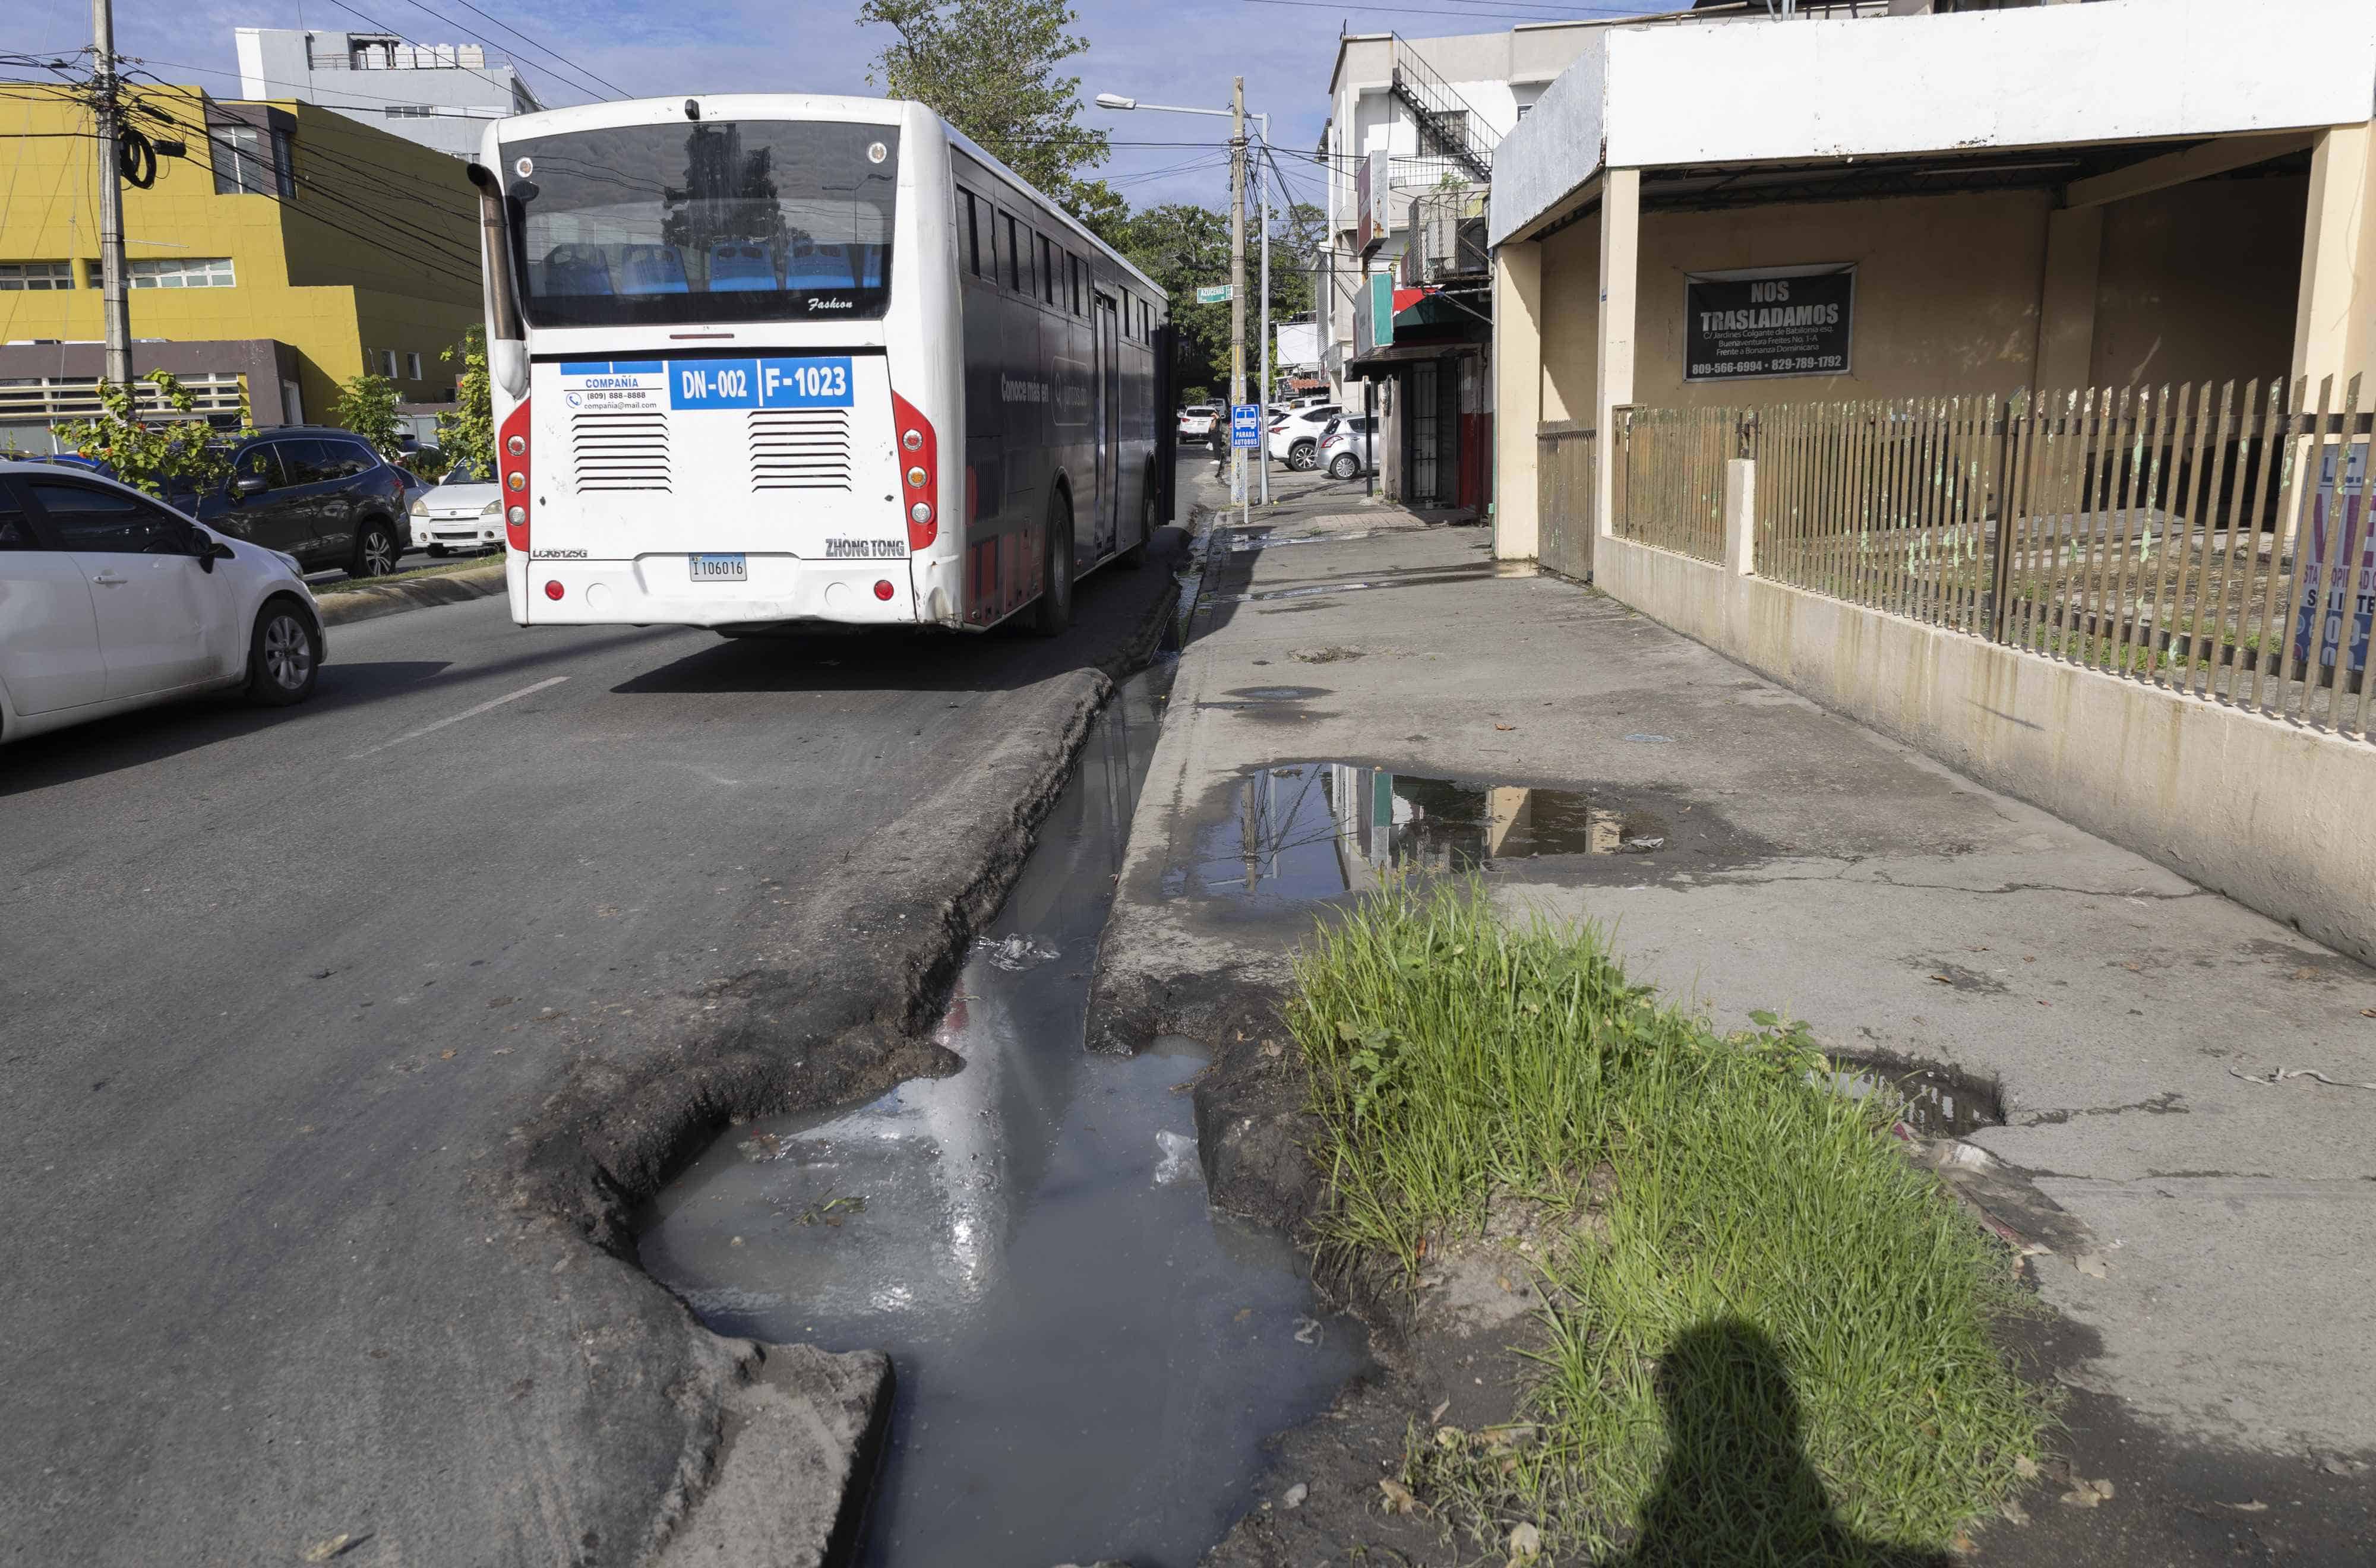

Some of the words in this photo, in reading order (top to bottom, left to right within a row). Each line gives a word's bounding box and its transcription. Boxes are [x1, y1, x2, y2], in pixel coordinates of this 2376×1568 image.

[1200, 288, 1225, 296] AZUCENAS
[1751, 281, 1790, 303] NOS
[808, 298, 852, 311] Fashion
[1701, 304, 1838, 332] TRASLADAMOS
[1719, 339, 1767, 347] Buenaventura
[1743, 330, 1774, 338] Colgante
[1692, 361, 1762, 374] 809-566-6994
[1772, 355, 1841, 370] 829-789-1792
[586, 375, 638, 388] COMPAÑÍA
[682, 370, 747, 399] DN-002
[765, 366, 846, 397] F-1023
[1001, 372, 1026, 403] Conoce
[1028, 375, 1040, 403] más
[1041, 383, 1048, 403] en
[826, 539, 869, 557] ZHONG
[870, 540, 905, 557] TONG
